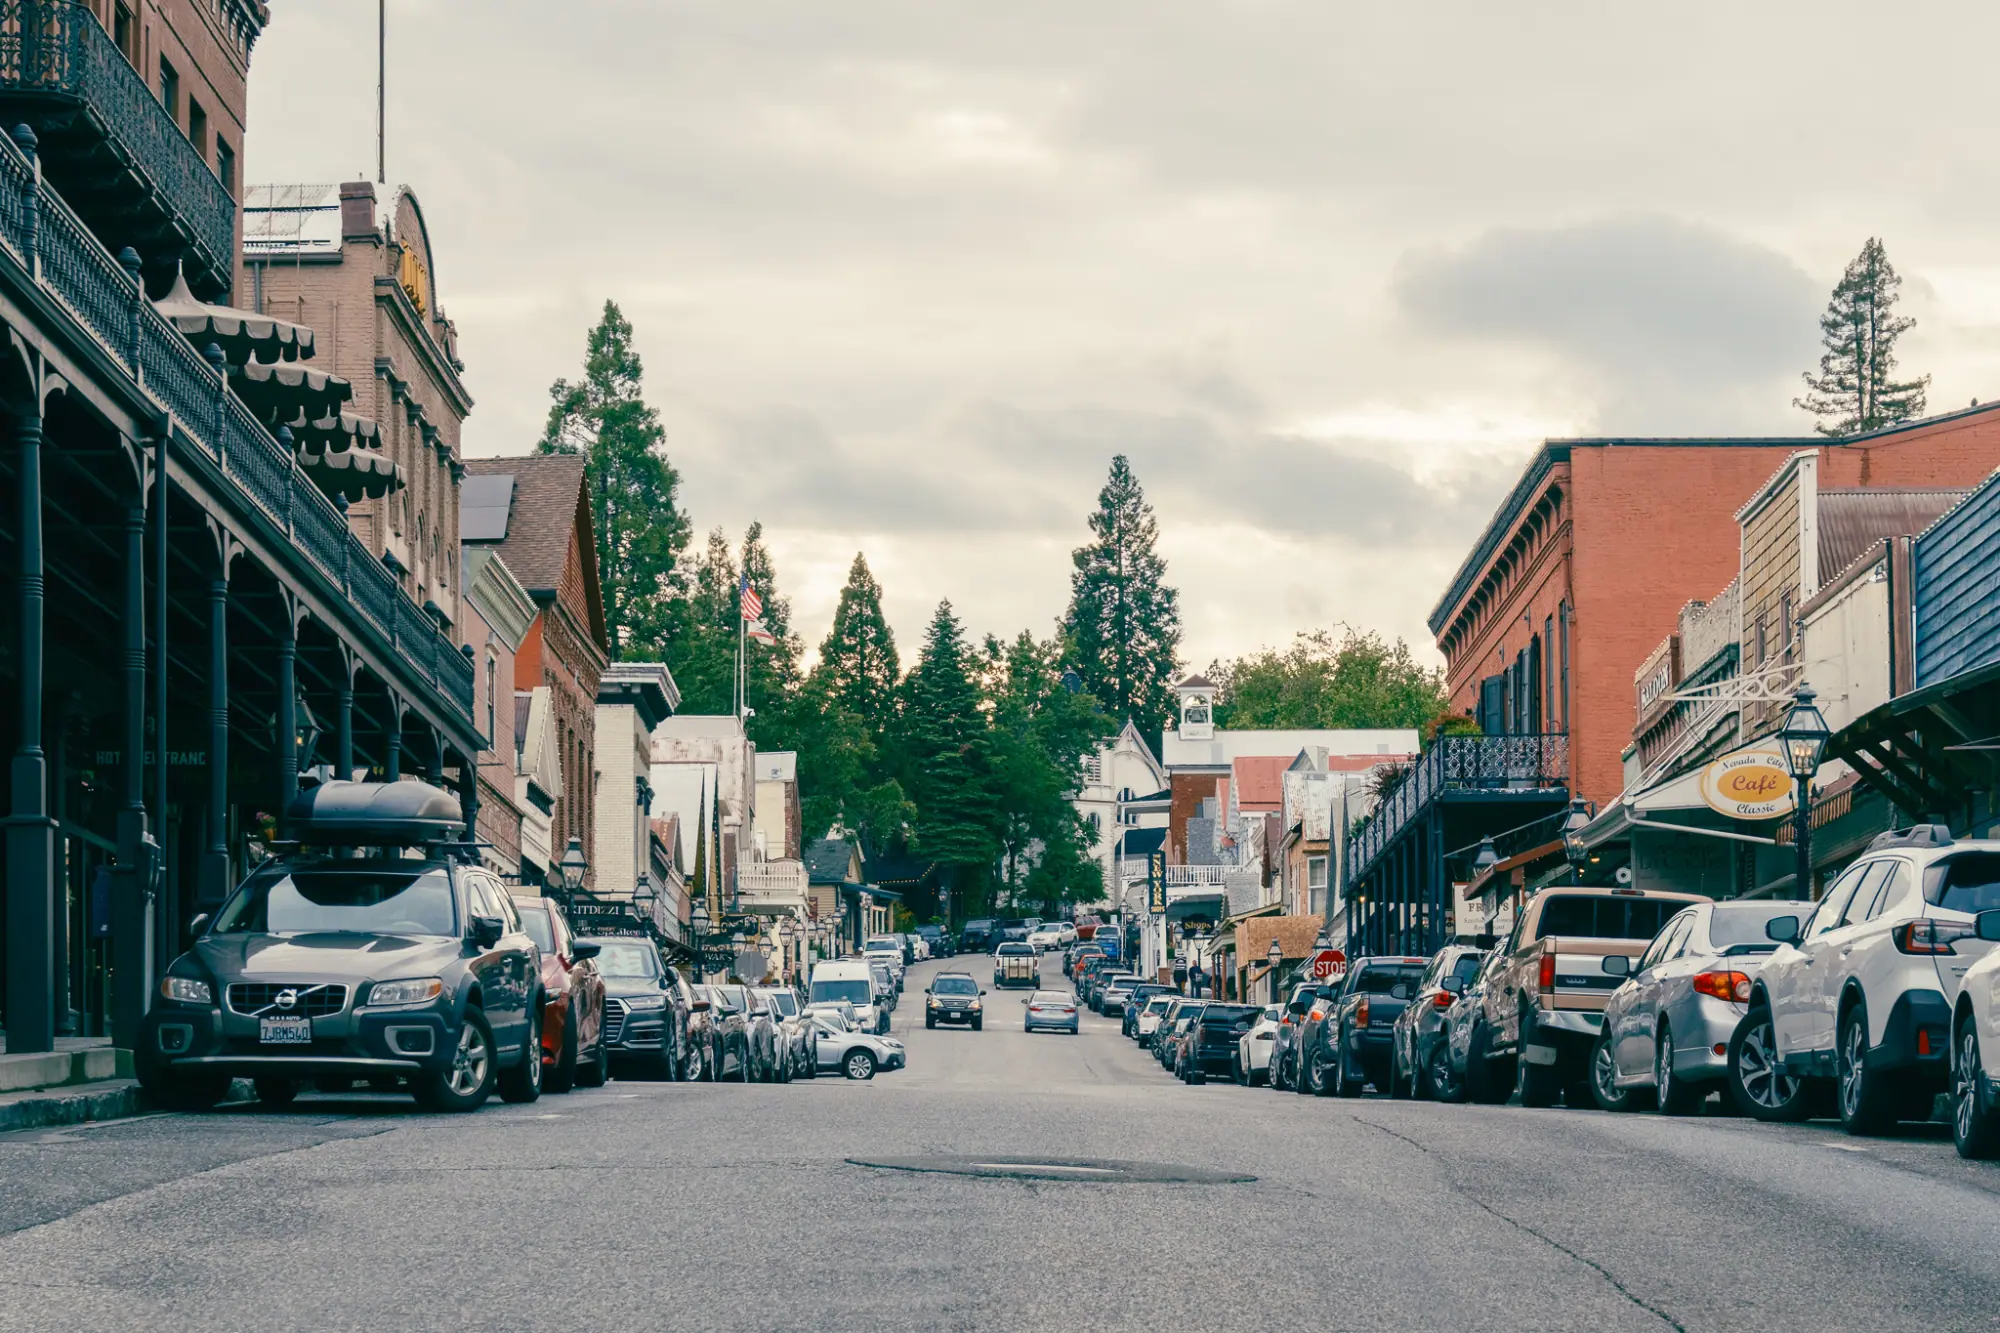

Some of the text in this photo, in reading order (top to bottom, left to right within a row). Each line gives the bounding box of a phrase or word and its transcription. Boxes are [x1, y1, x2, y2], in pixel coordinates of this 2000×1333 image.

[1641, 663, 1669, 711] SALOON
[1721, 755, 1785, 772] Nevada City
[1732, 774, 1777, 795] Café
[1736, 803, 1776, 815] Classic
[1152, 880, 1163, 905] YORK
[1184, 921, 1212, 932] Shops
[1316, 961, 1347, 976] STOP
